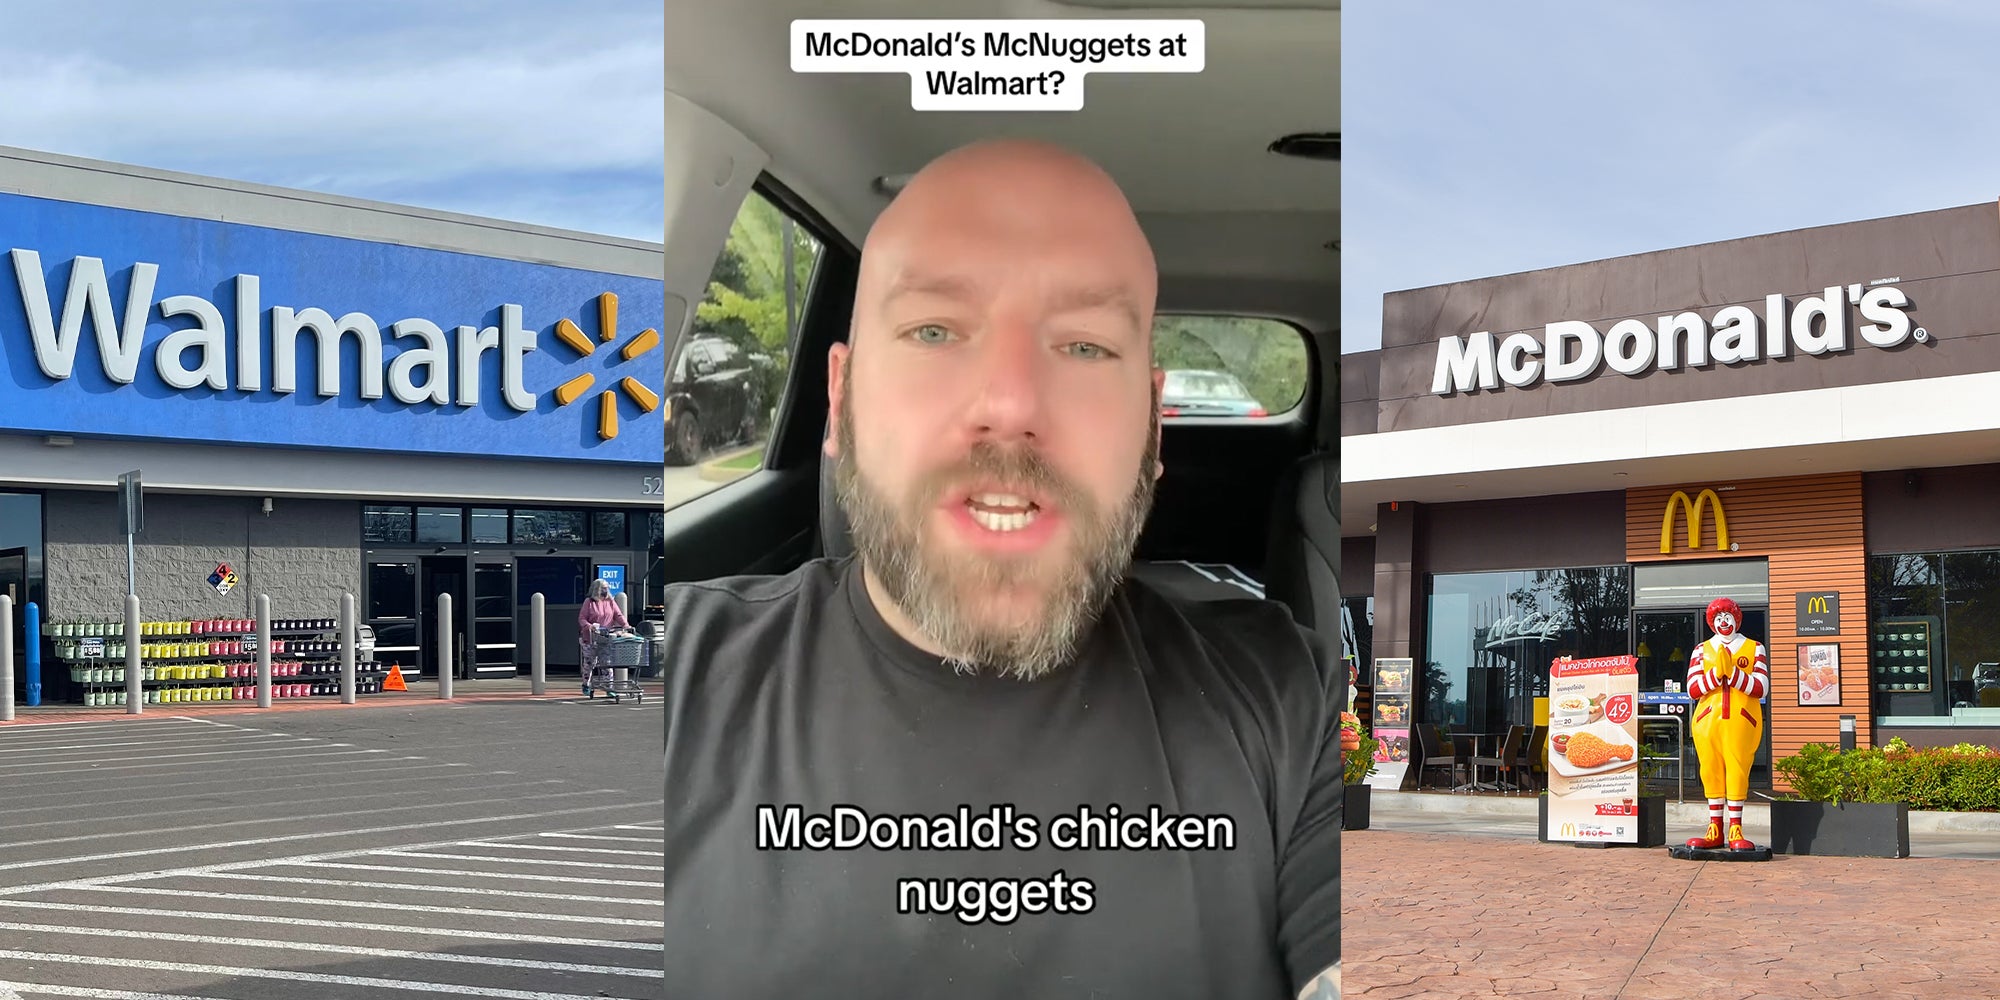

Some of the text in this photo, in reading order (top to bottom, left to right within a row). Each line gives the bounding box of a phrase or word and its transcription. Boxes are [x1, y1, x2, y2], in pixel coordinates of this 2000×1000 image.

[11, 247, 537, 412] Walmart
[642, 476, 663, 495] 52
[218, 565, 228, 576] 4
[602, 570, 619, 579] EXIT
[227, 573, 236, 584] 2
